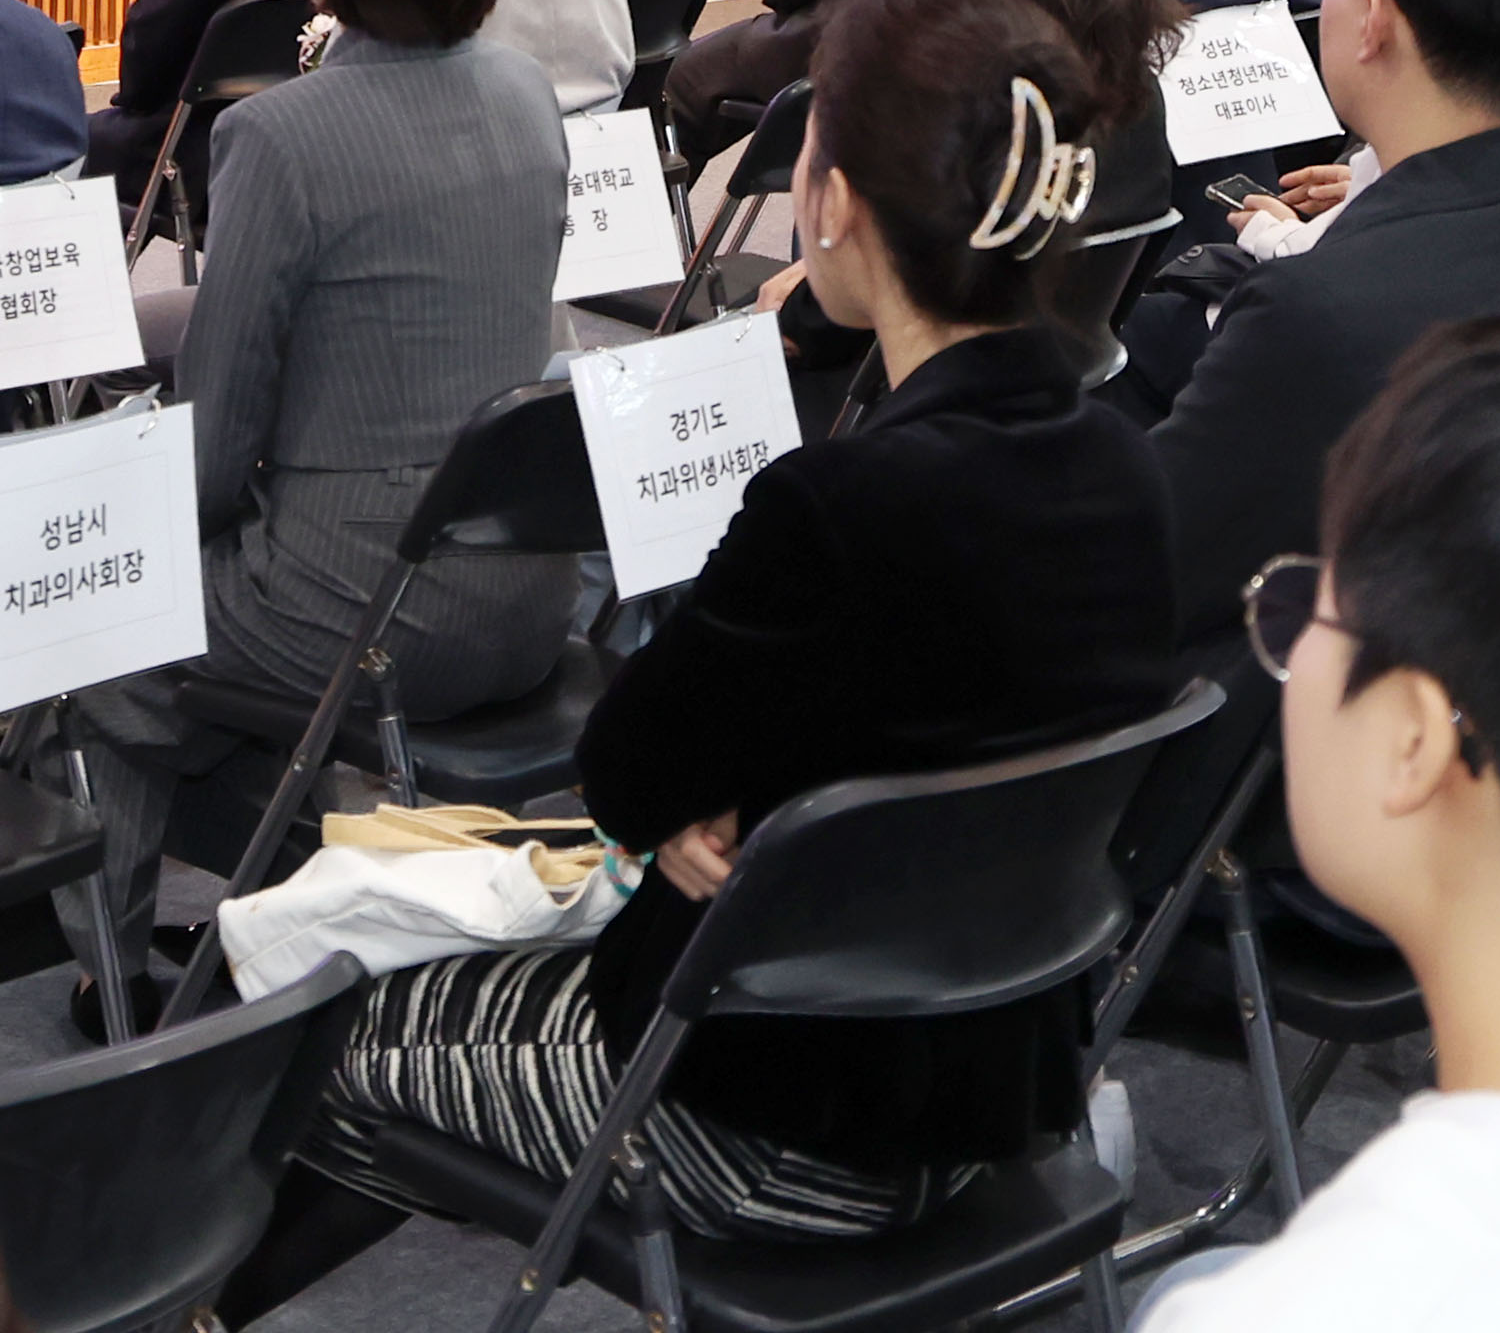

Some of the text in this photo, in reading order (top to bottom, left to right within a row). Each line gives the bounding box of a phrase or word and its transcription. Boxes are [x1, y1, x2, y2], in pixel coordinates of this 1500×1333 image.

[1214, 93, 1278, 121] 대표이사
[567, 167, 635, 197] 술대학교
[591, 207, 609, 232] 장
[0, 287, 57, 321] 협회장
[669, 402, 728, 442] 경기도
[637, 439, 770, 503] 치과위생사회장
[40, 502, 107, 551] 성남시
[4, 548, 145, 616] 치과의사회장
